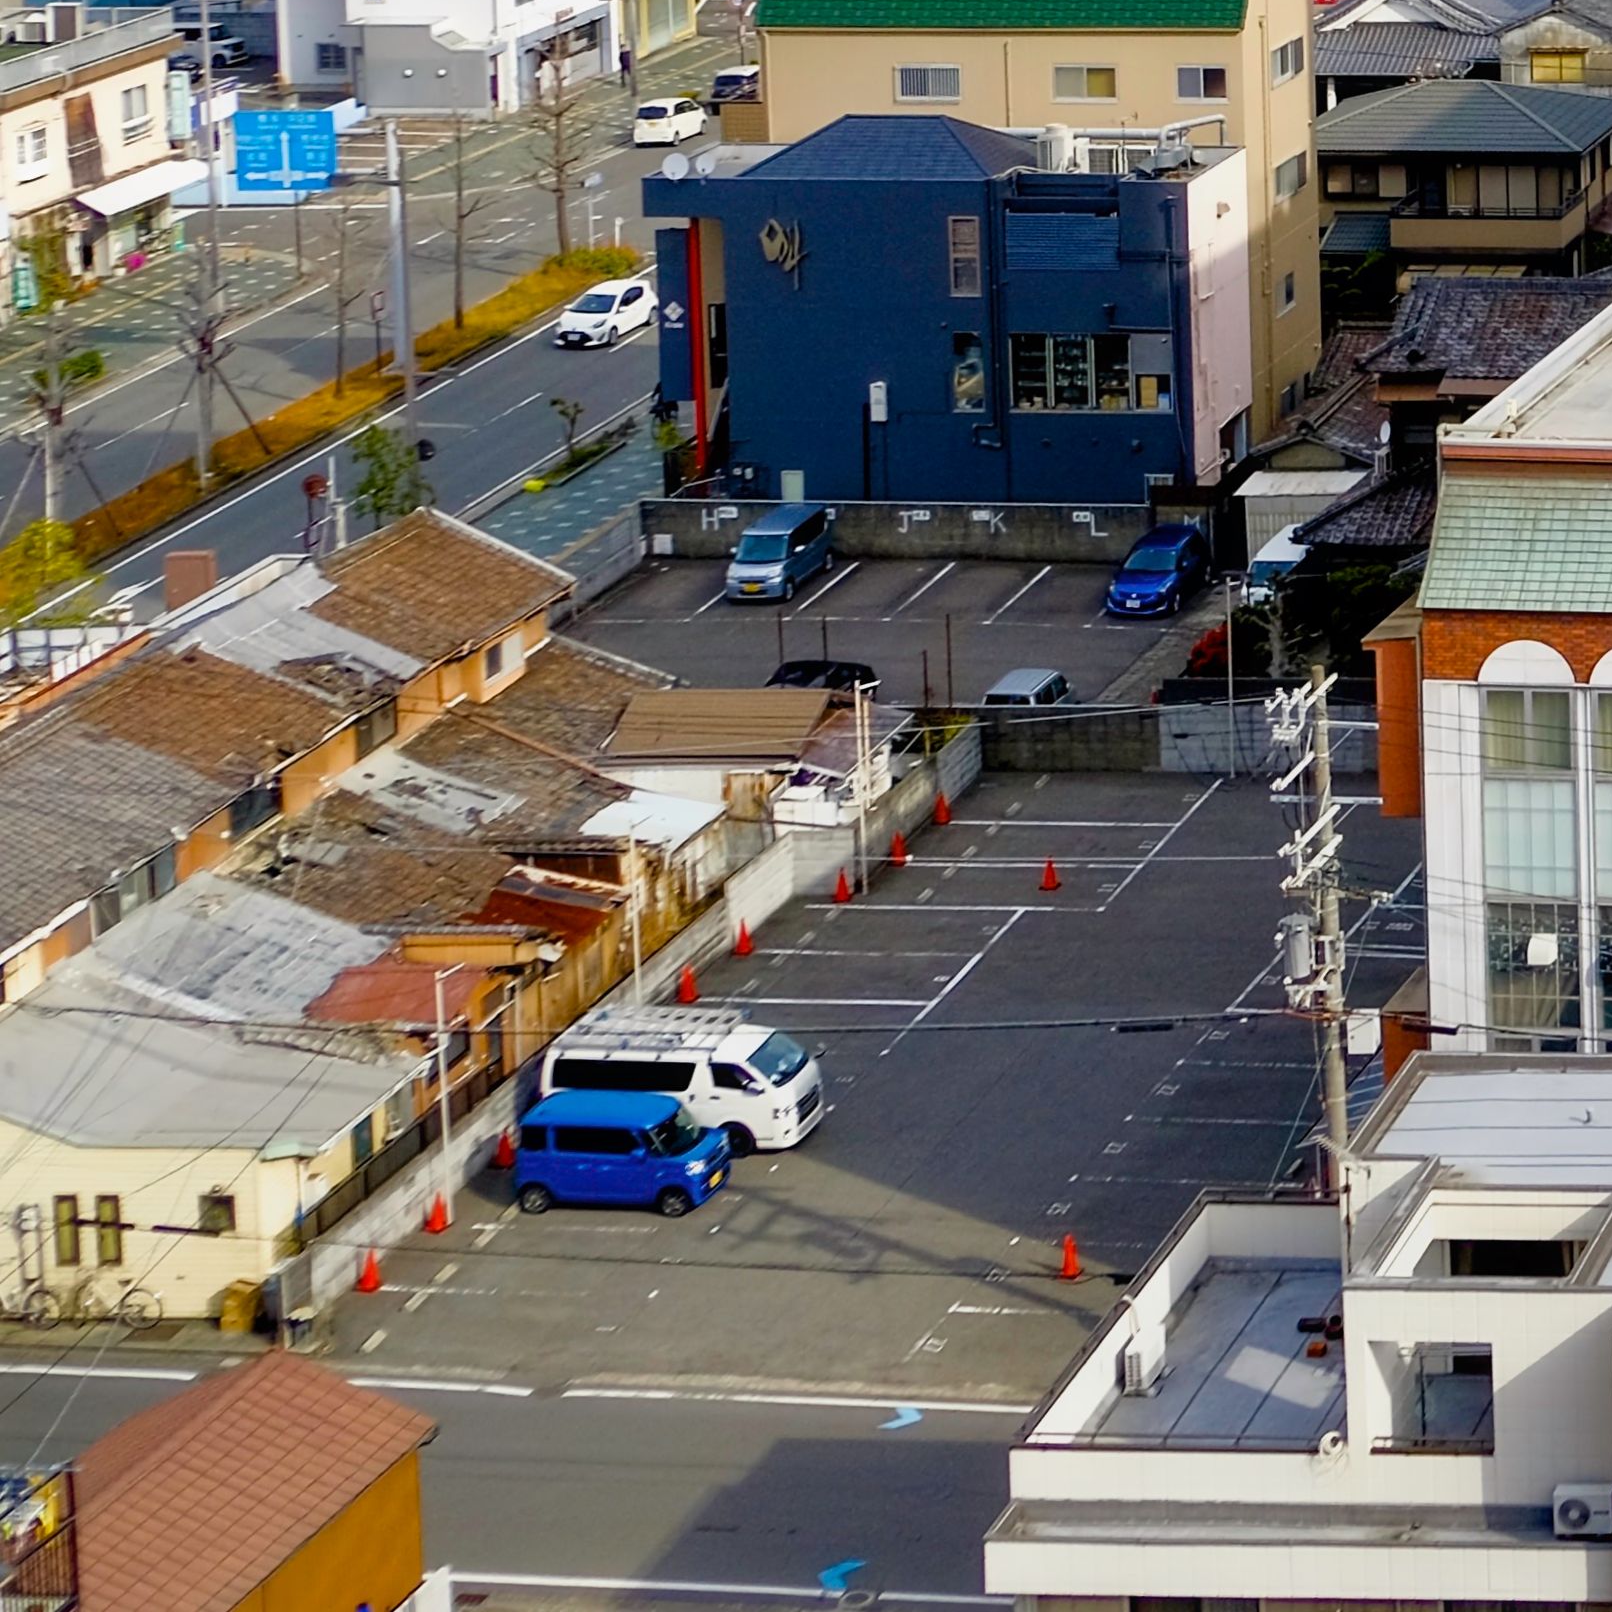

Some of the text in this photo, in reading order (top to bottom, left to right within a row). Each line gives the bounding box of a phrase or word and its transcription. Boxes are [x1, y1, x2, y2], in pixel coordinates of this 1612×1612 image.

[701, 509, 719, 531] H
[990, 511, 1007, 533] K
[1090, 512, 1109, 537] L
